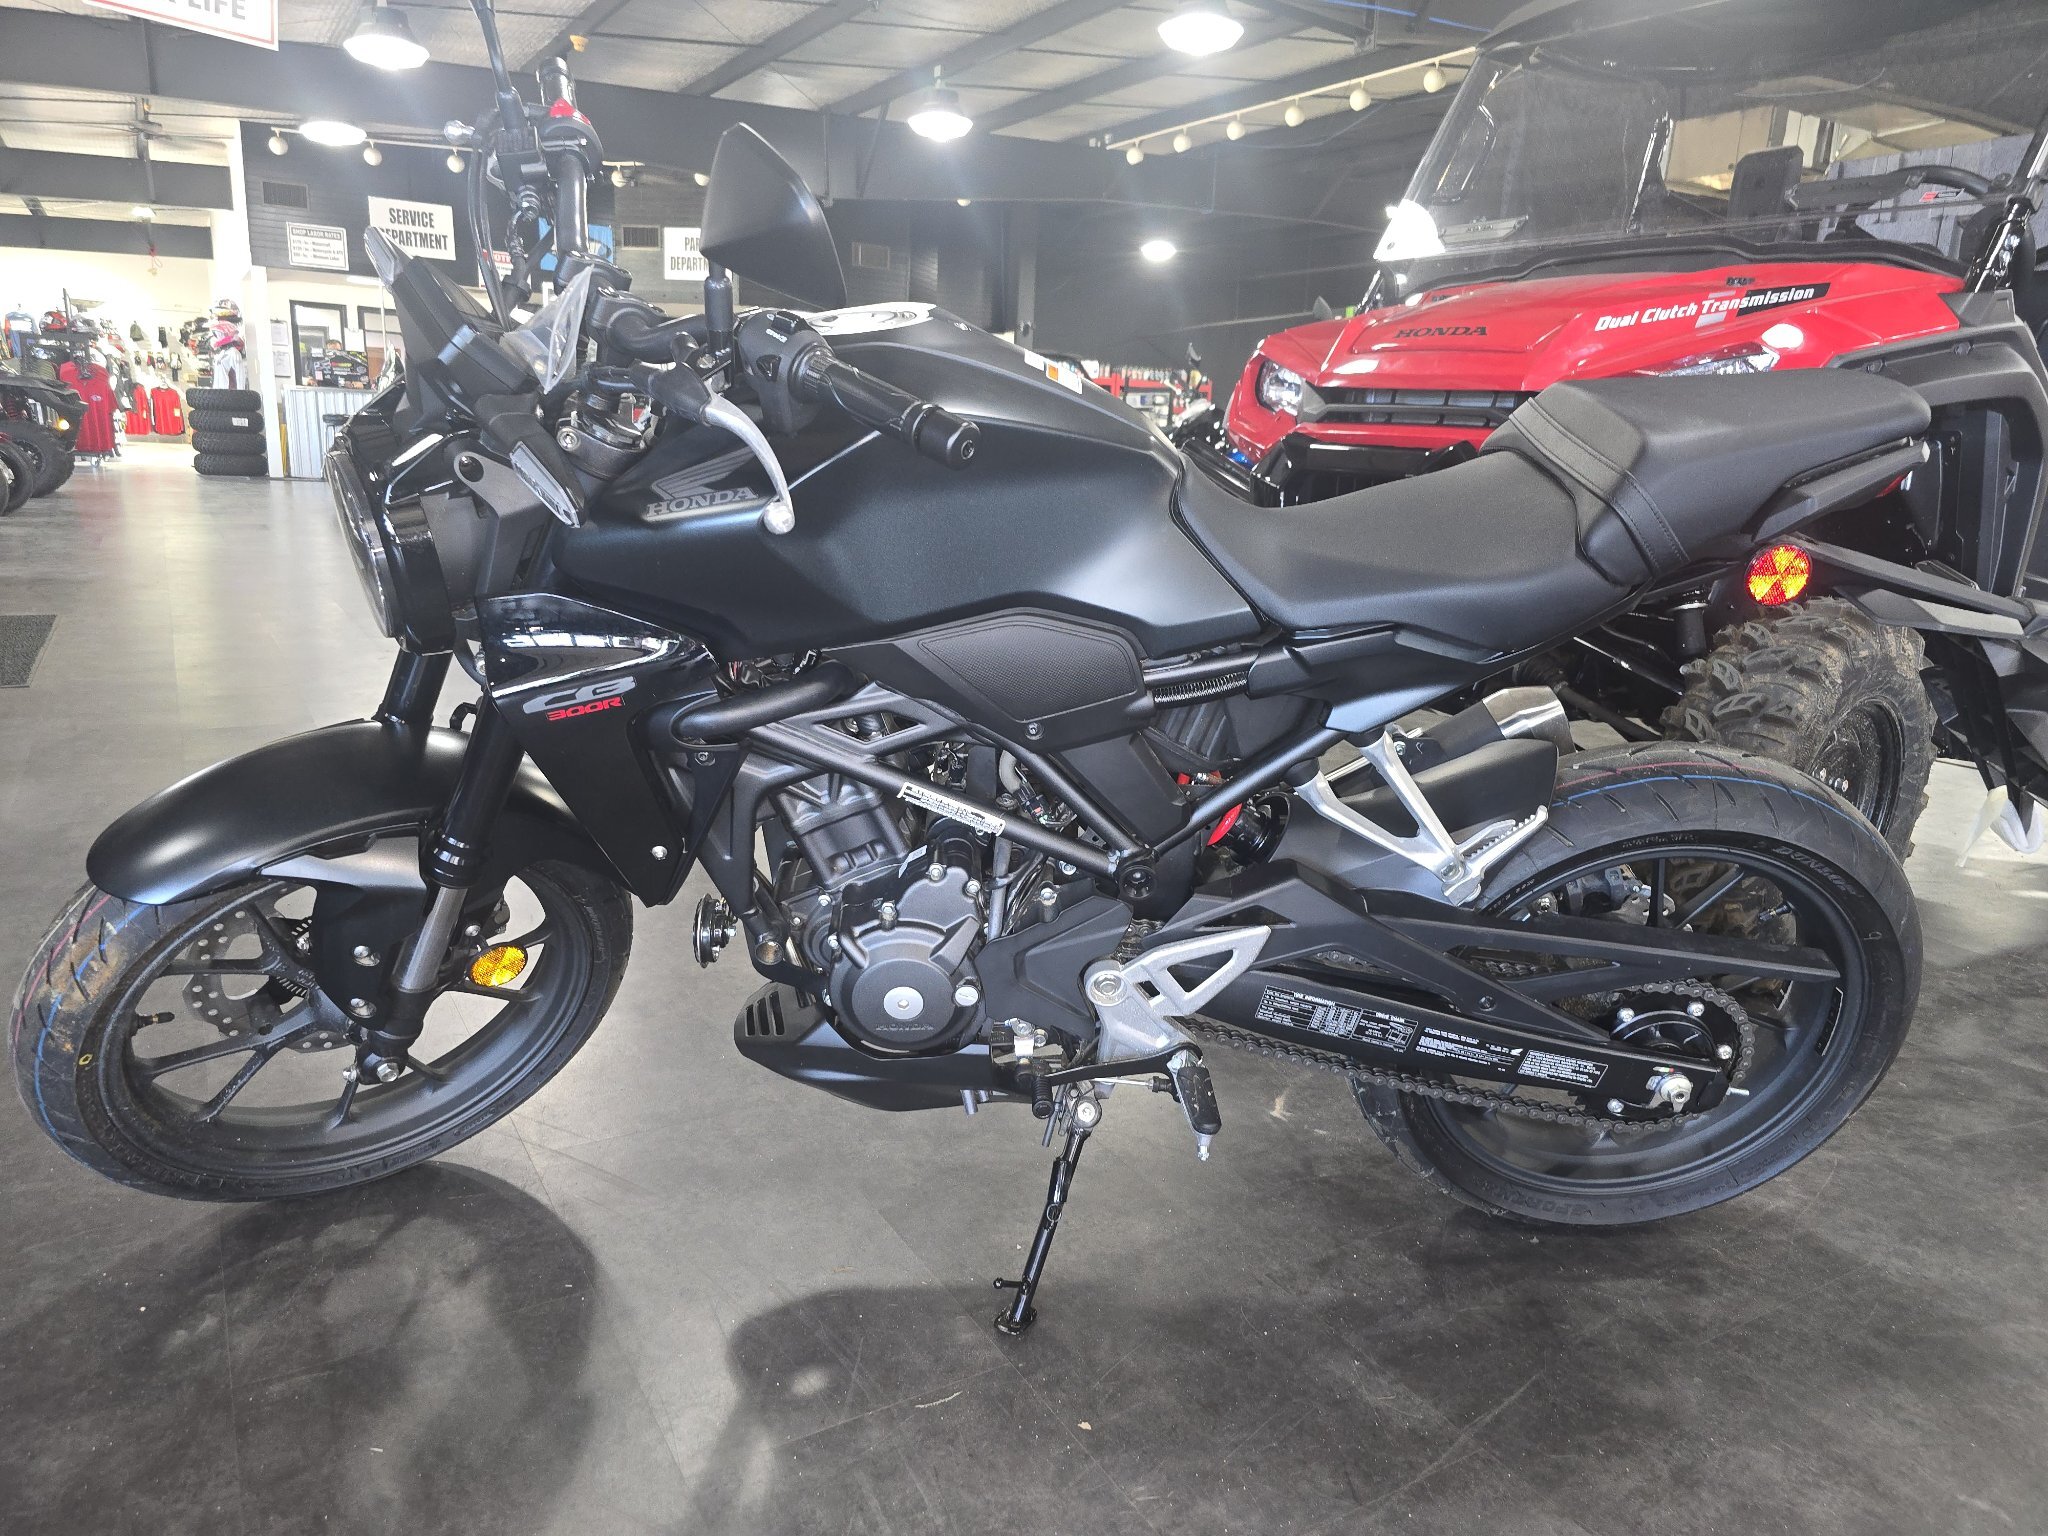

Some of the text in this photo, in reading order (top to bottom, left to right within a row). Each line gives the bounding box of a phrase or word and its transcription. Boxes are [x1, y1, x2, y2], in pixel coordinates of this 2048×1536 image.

[388, 207, 435, 229] SERVICE
[380, 227, 448, 251] PARTMENT
[684, 236, 700, 251] PAR
[670, 256, 709, 272] DEPARTM
[1594, 286, 1816, 332] Dual Clutch Transmission
[1394, 325, 1488, 339] HONDA
[645, 486, 760, 518] HONDA
[522, 675, 637, 715] CB
[546, 696, 623, 721] 300R
